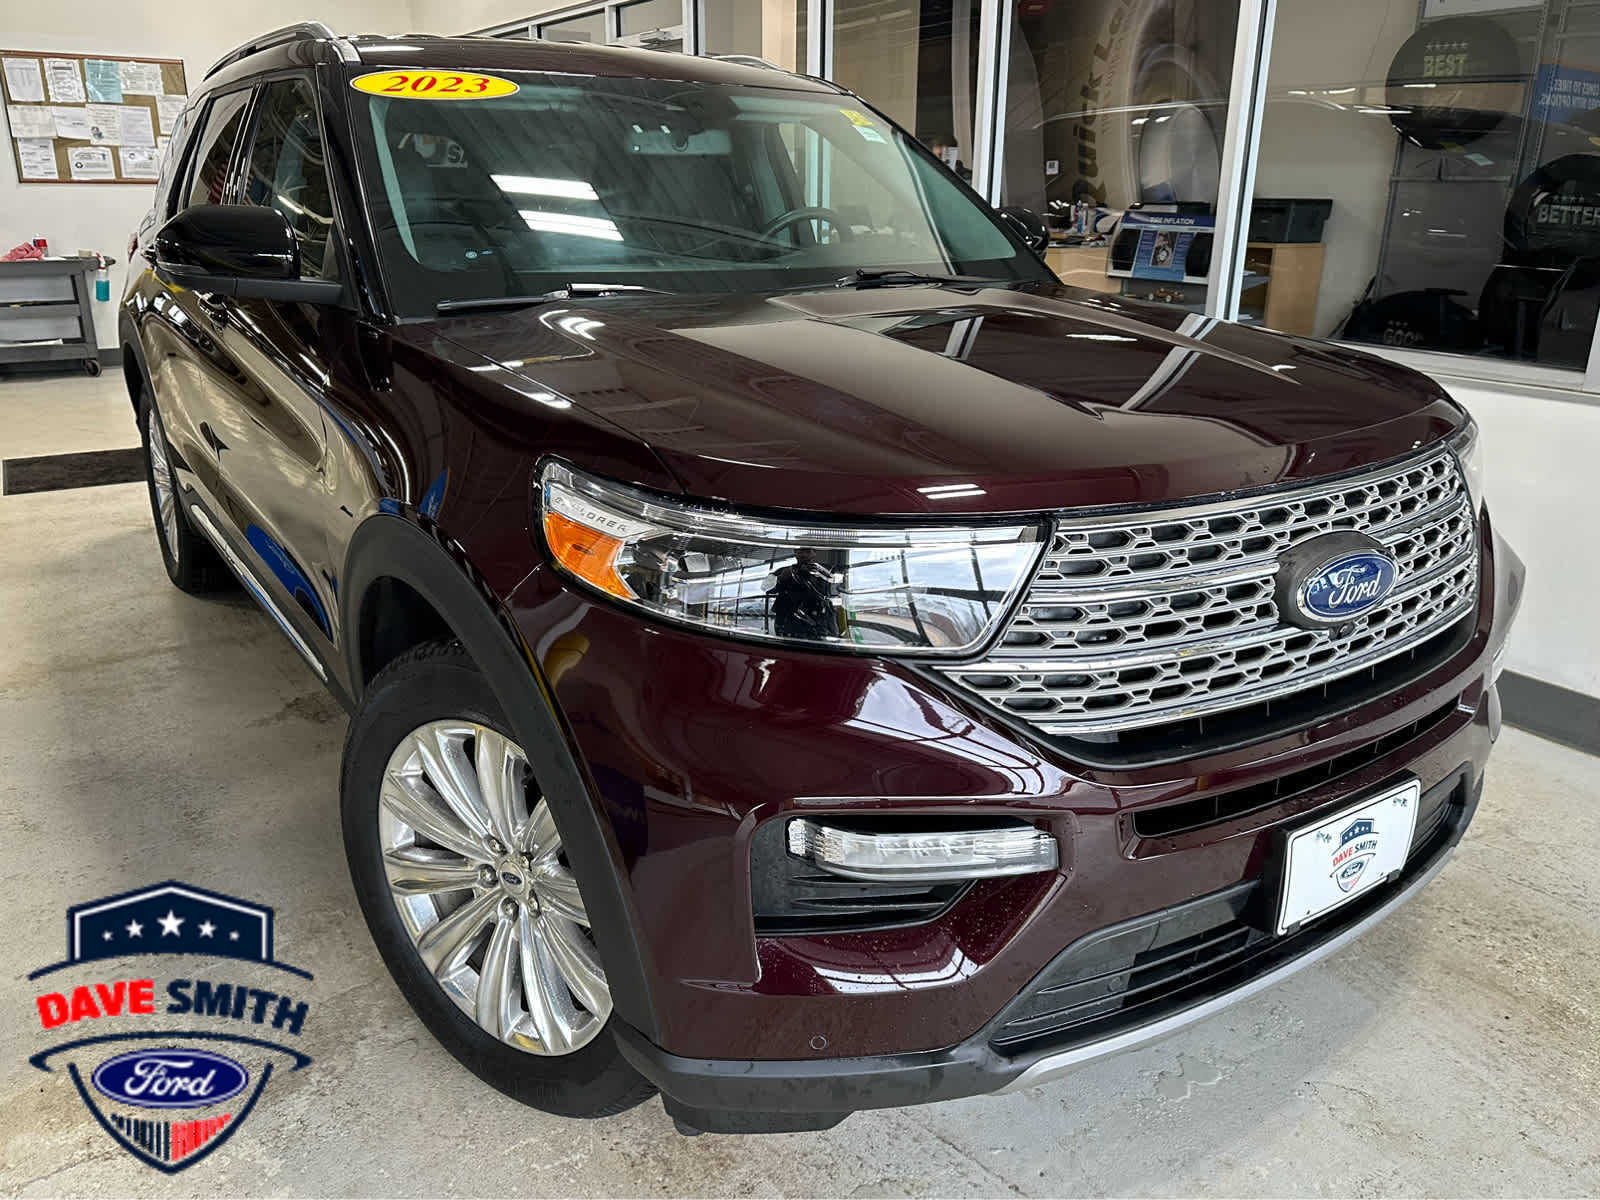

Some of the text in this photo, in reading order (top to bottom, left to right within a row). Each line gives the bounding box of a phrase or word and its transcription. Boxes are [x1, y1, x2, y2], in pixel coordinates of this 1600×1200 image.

[1423, 54, 1468, 77] BEST
[381, 75, 491, 93] 2023
[1162, 217, 1196, 226] INFLATION
[1328, 564, 1382, 609] Ford
[1332, 840, 1377, 868] DAVE SMITH
